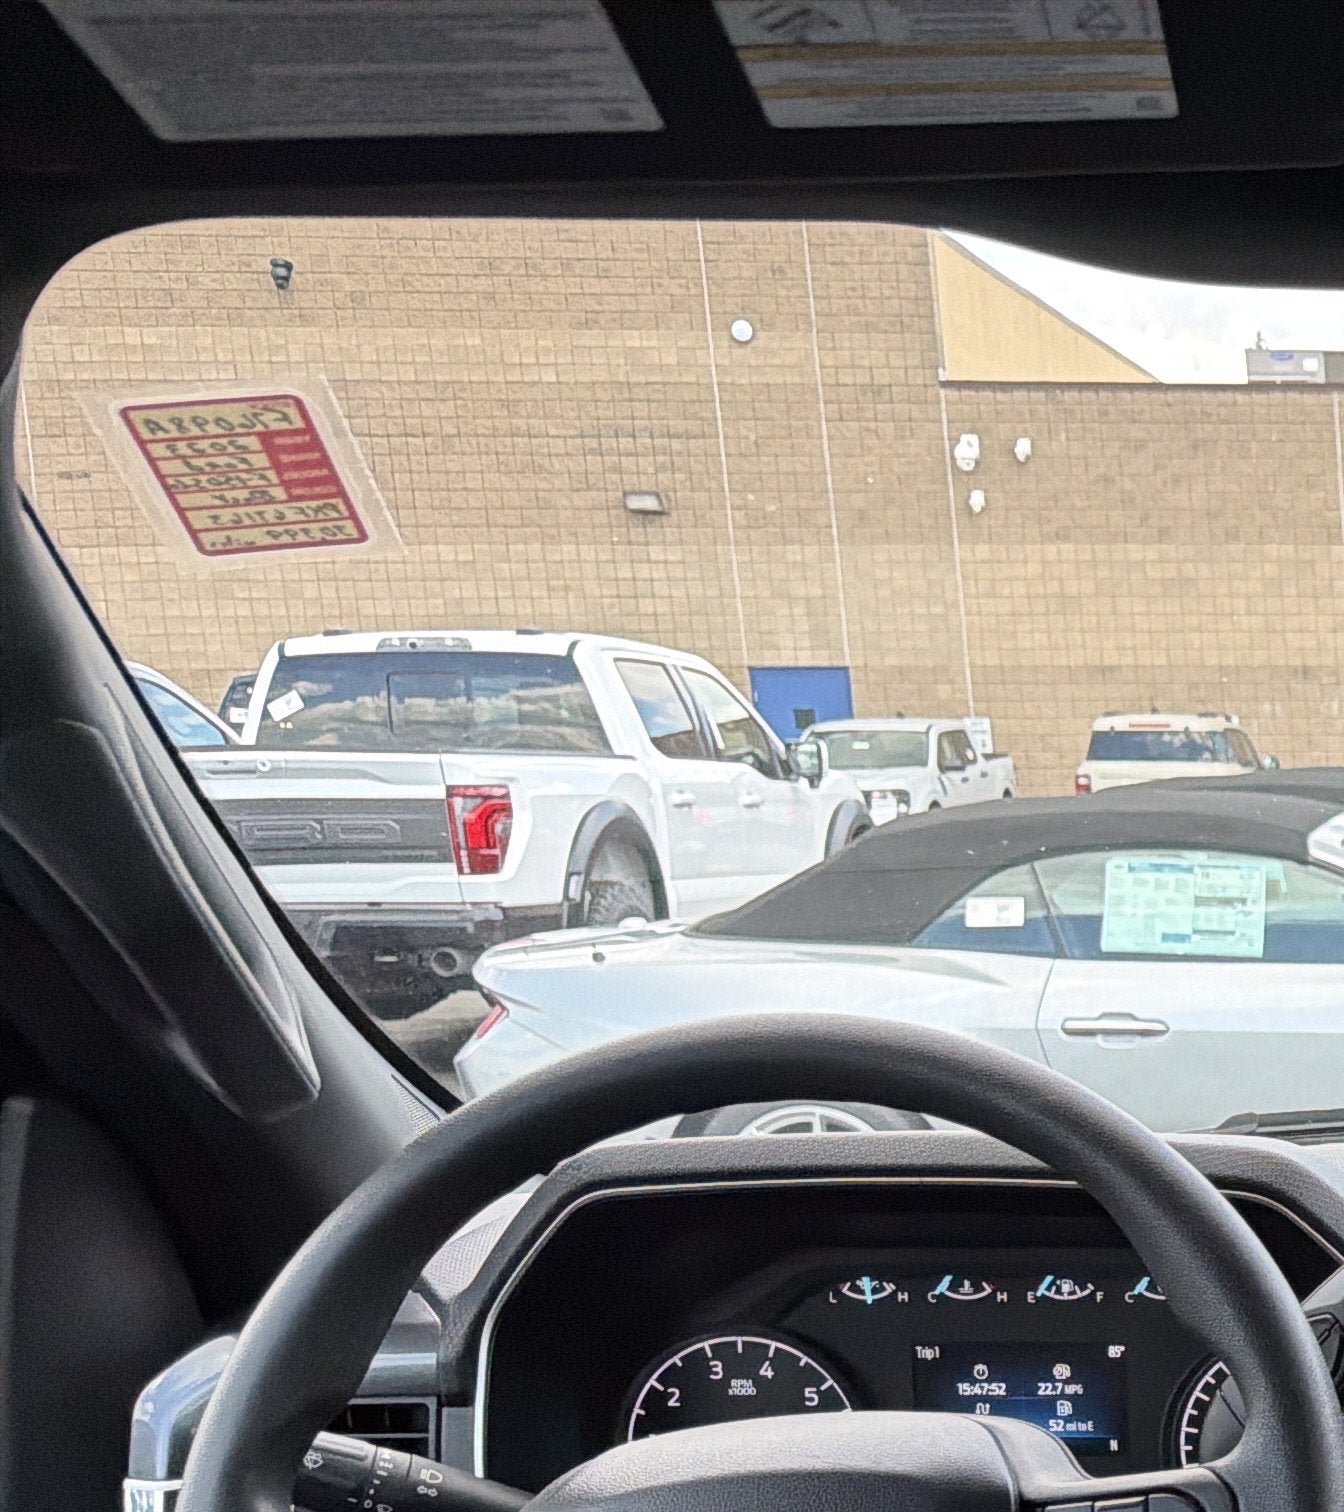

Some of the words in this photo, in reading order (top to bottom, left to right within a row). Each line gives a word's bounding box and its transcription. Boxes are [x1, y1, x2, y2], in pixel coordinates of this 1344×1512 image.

[829, 1292, 838, 1302] L
[898, 1292, 908, 1302] H
[928, 1292, 936, 1302] C
[997, 1292, 1008, 1302] H
[1028, 1292, 1036, 1302] E
[1096, 1292, 1104, 1302] F
[1125, 1292, 1134, 1302] C
[915, 1346, 934, 1360] Trip
[709, 1361, 724, 1380] 3
[759, 1361, 774, 1380] 4
[731, 1379, 752, 1388] RPM
[728, 1388, 757, 1396] x1000
[1038, 1383, 1062, 1395] 22.7
[667, 1388, 681, 1407] 2
[804, 1388, 819, 1406] 5
[1049, 1420, 1064, 1432] 52
